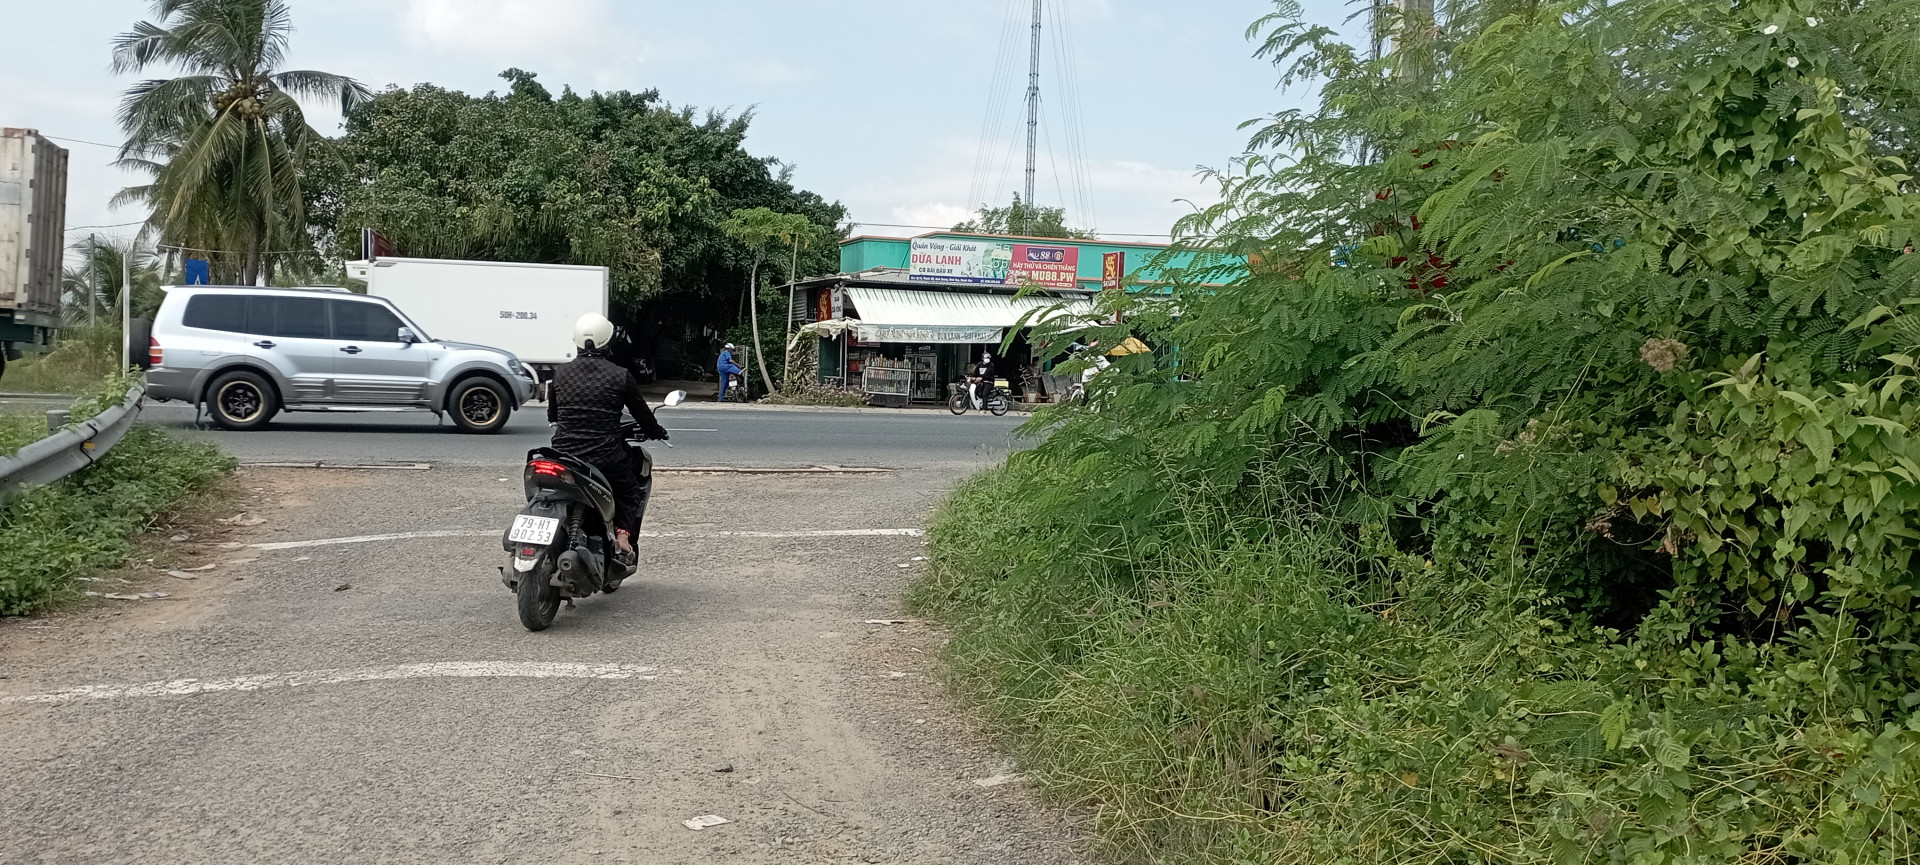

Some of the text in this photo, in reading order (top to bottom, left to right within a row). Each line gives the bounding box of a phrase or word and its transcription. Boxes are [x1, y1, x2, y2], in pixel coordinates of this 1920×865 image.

[912, 241, 928, 250] Quán
[929, 243, 944, 251] Võng
[912, 252, 962, 266] DỪA LẠNH
[1032, 270, 1074, 282] MU88.PW
[520, 518, 551, 530] 79-H1
[512, 528, 552, 542] 902.53
